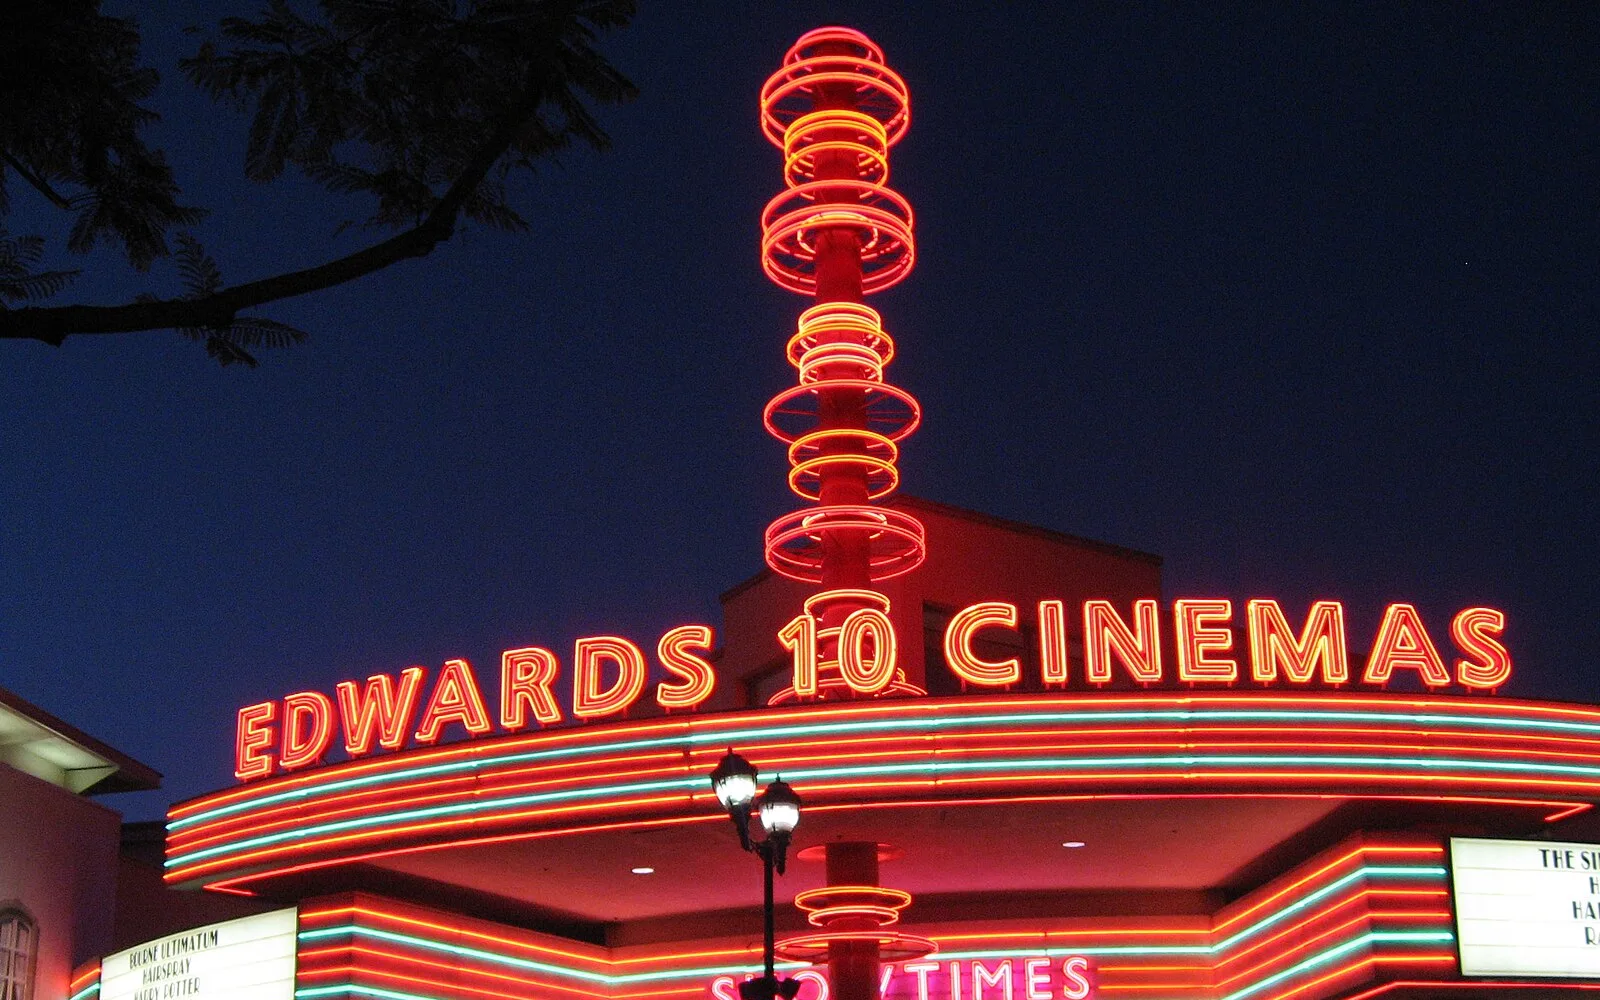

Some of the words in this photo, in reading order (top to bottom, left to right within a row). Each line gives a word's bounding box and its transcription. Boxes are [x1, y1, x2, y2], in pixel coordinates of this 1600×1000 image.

[235, 625, 716, 780] EDWARDS
[777, 607, 898, 697] 10
[943, 599, 1512, 688] CINEMAS
[1539, 849, 1575, 869] THE
[1581, 851, 1600, 870] SI
[1572, 900, 1600, 920] HA
[129, 944, 158, 970] BOURNE
[161, 929, 218, 960] ULTIMATUM
[143, 957, 191, 985] HAIRSPRAY
[164, 976, 200, 999] POTTER
